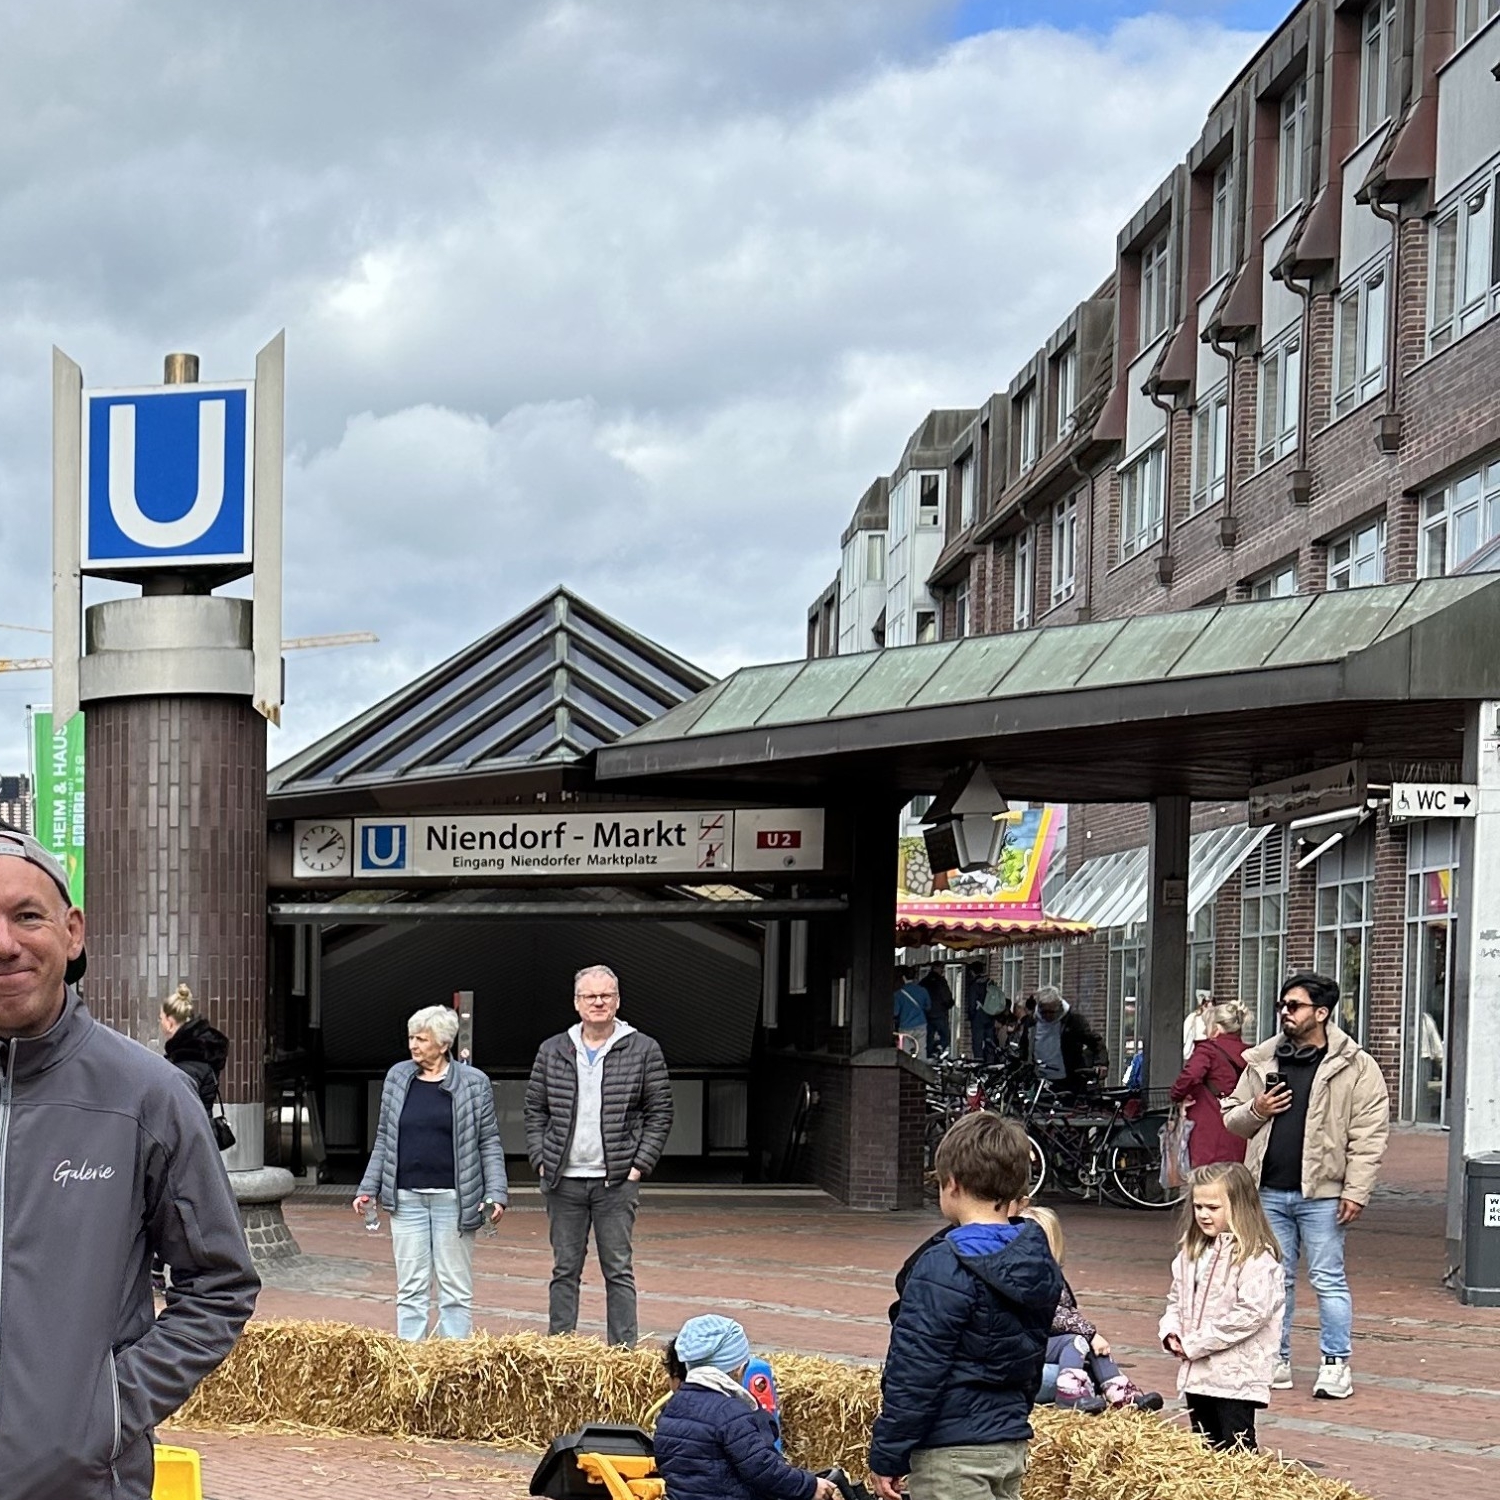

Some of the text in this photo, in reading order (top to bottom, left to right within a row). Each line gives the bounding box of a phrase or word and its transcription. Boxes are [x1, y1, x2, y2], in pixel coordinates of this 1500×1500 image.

[109, 399, 226, 549] U
[53, 781, 68, 795] &
[1417, 790, 1447, 810] WC
[52, 799, 68, 848] HEIM
[426, 822, 568, 851] Niendorf
[593, 820, 687, 848] Markt
[367, 827, 400, 866] U
[453, 853, 658, 869] Eingang Niendorfer Marktplatz
[53, 1159, 115, 1187] Galerie
